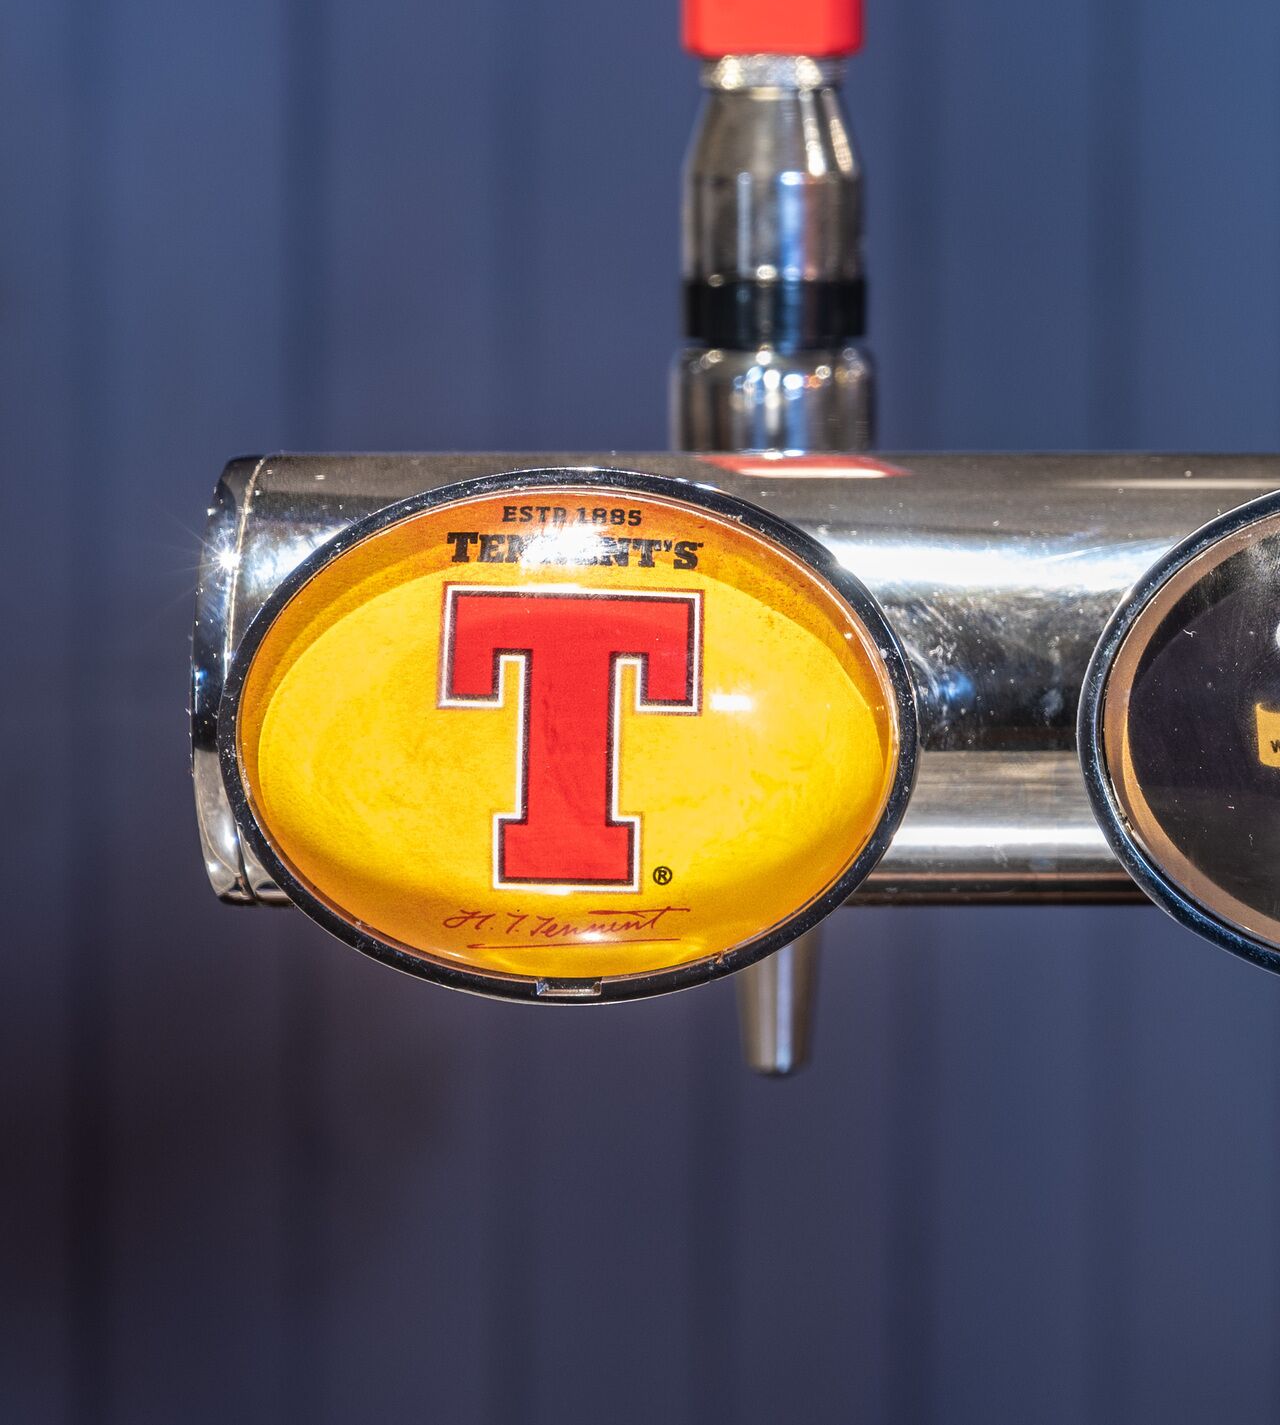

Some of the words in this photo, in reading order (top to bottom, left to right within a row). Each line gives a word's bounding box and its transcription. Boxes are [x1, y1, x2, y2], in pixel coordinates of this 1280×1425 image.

[577, 507, 642, 527] 1885
[447, 531, 704, 570] TENNT'S
[437, 582, 705, 893] T
